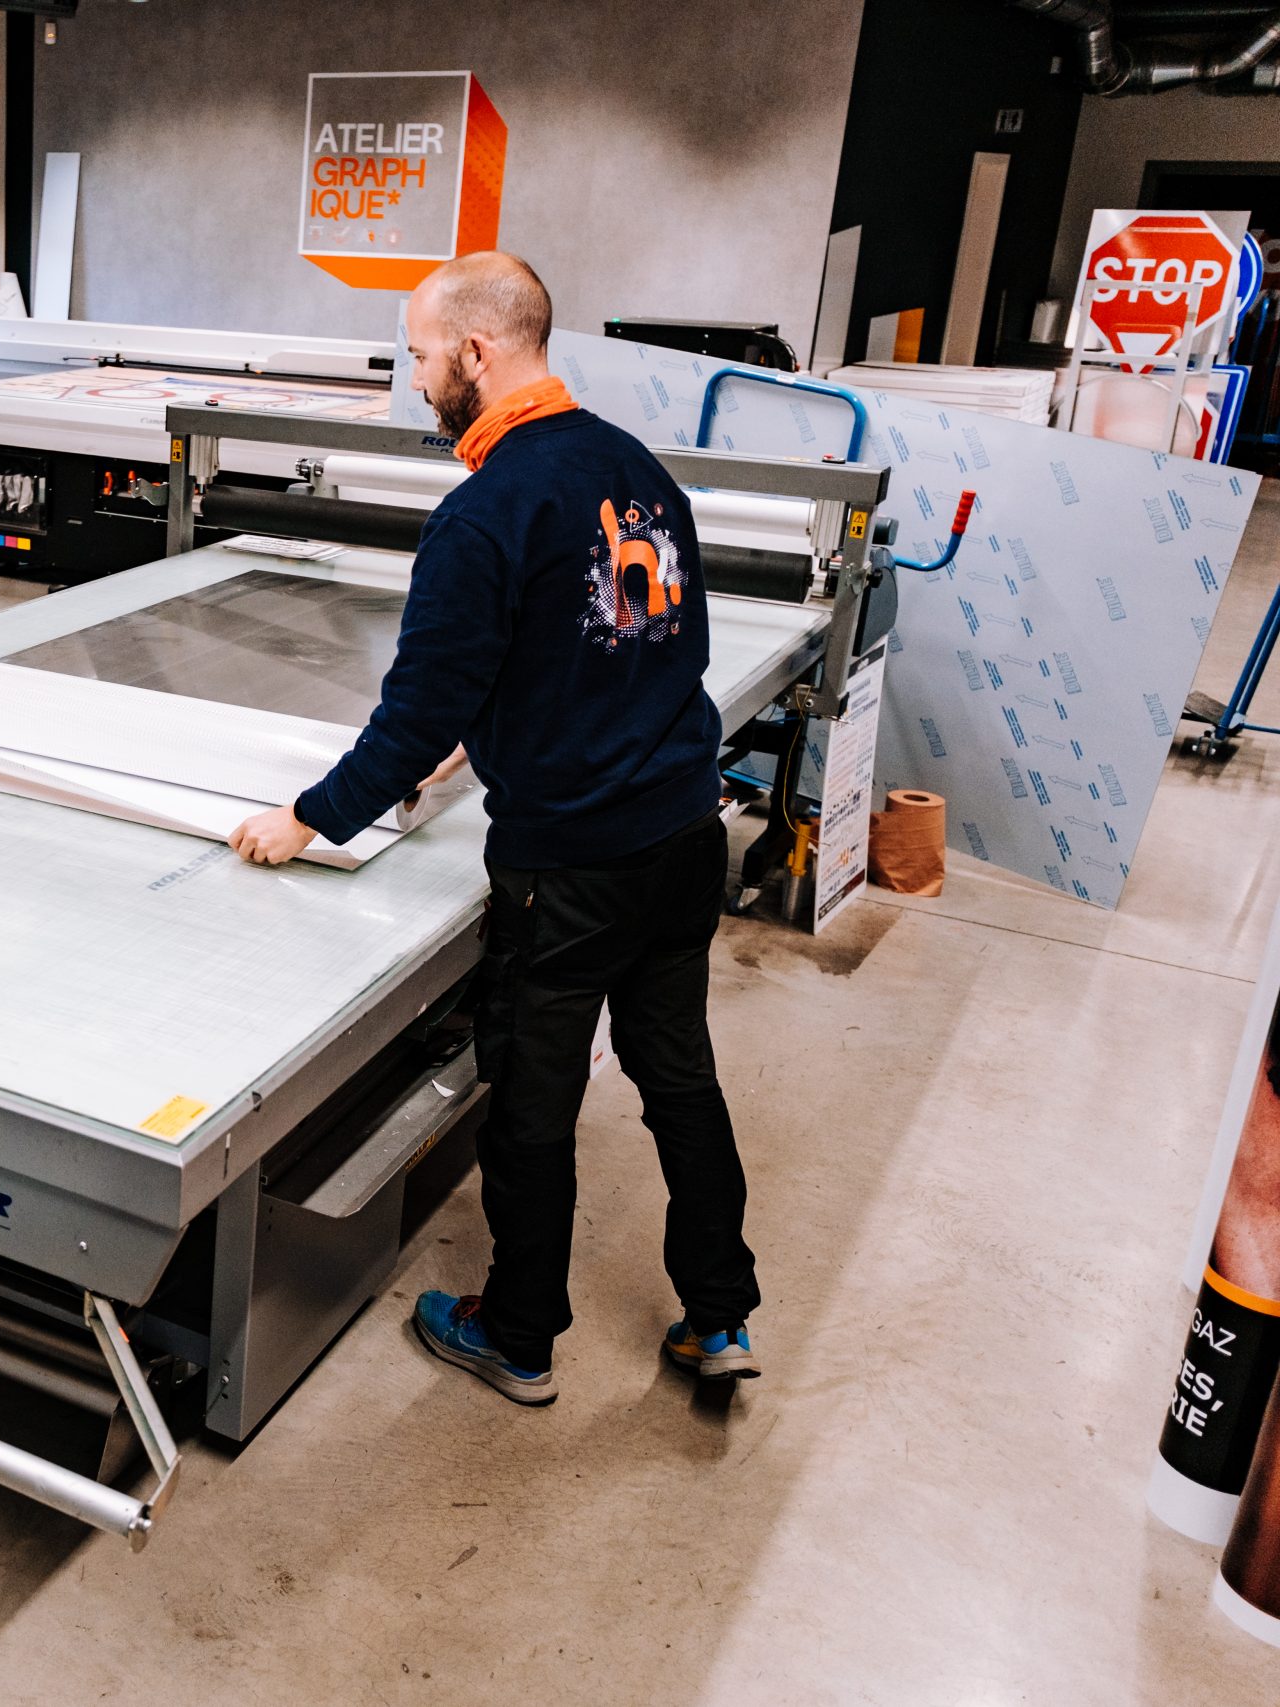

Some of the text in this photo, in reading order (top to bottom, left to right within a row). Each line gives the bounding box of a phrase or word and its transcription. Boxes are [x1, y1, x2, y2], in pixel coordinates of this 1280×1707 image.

[314, 123, 444, 154] ATELIER
[313, 156, 426, 188] GRAPH
[1092, 256, 1223, 305] STOP
[1178, 1356, 1224, 1412] ES,
